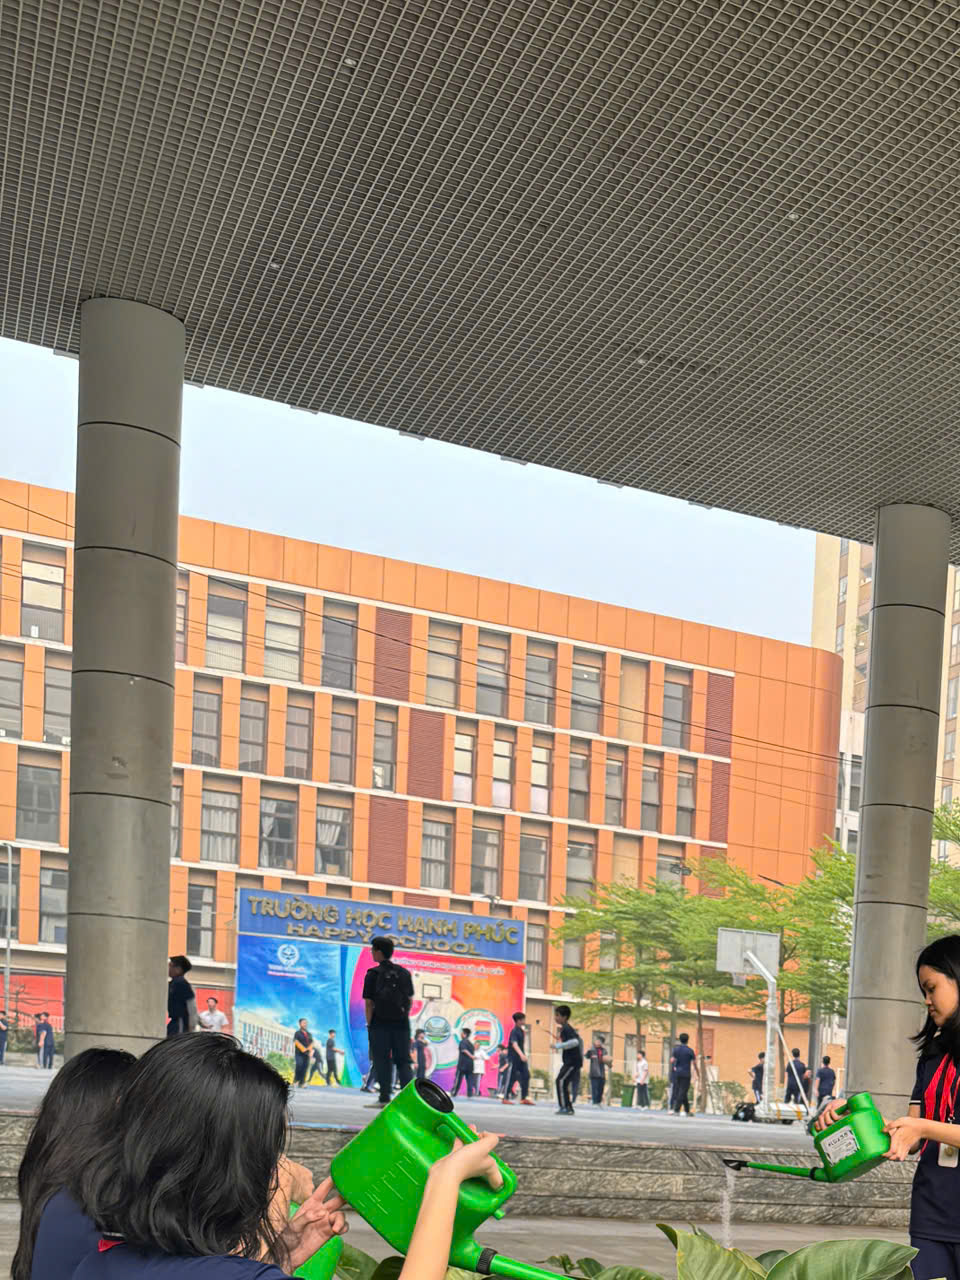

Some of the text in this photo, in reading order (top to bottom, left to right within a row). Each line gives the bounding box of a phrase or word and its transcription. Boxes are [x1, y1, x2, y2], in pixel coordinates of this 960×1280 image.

[287, 922, 483, 955] HAPPY SCHOOL
[345, 907, 392, 932] HỌC
[463, 920, 519, 945] PHÚC
